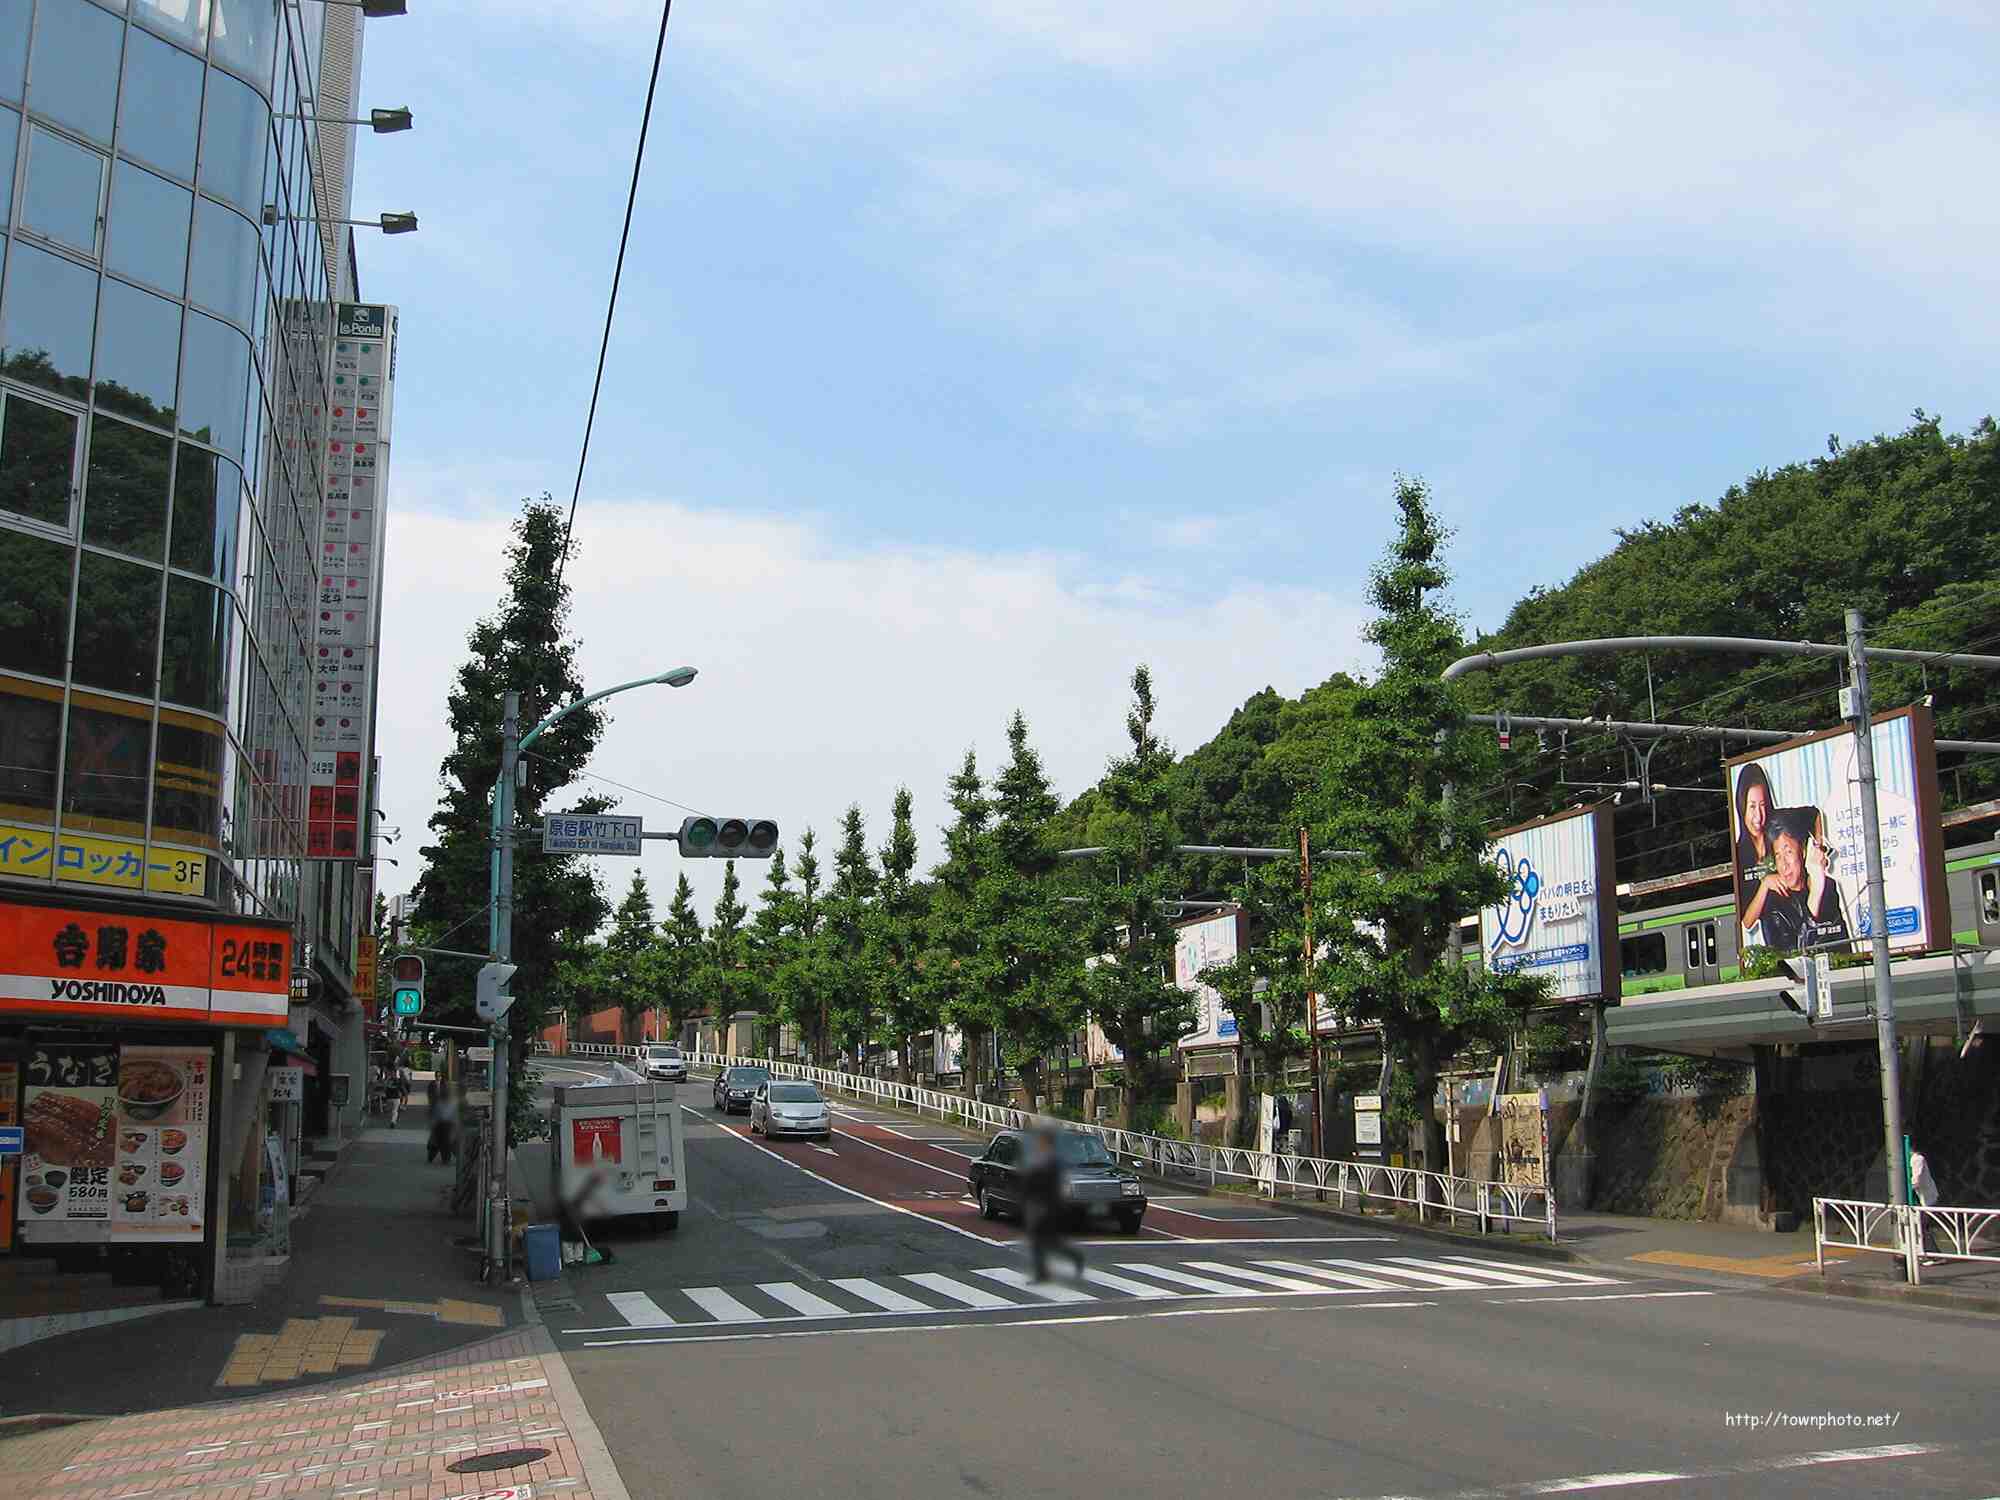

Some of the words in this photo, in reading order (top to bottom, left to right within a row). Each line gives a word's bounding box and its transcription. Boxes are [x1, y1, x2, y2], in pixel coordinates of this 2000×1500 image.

[550, 819, 637, 840] 原宿駅竹下口
[174, 860, 202, 884] 3F
[53, 922, 167, 974] 吉野家
[51, 980, 166, 1006] YOSHINOYA
[29, 1051, 116, 1084] うなぎ
